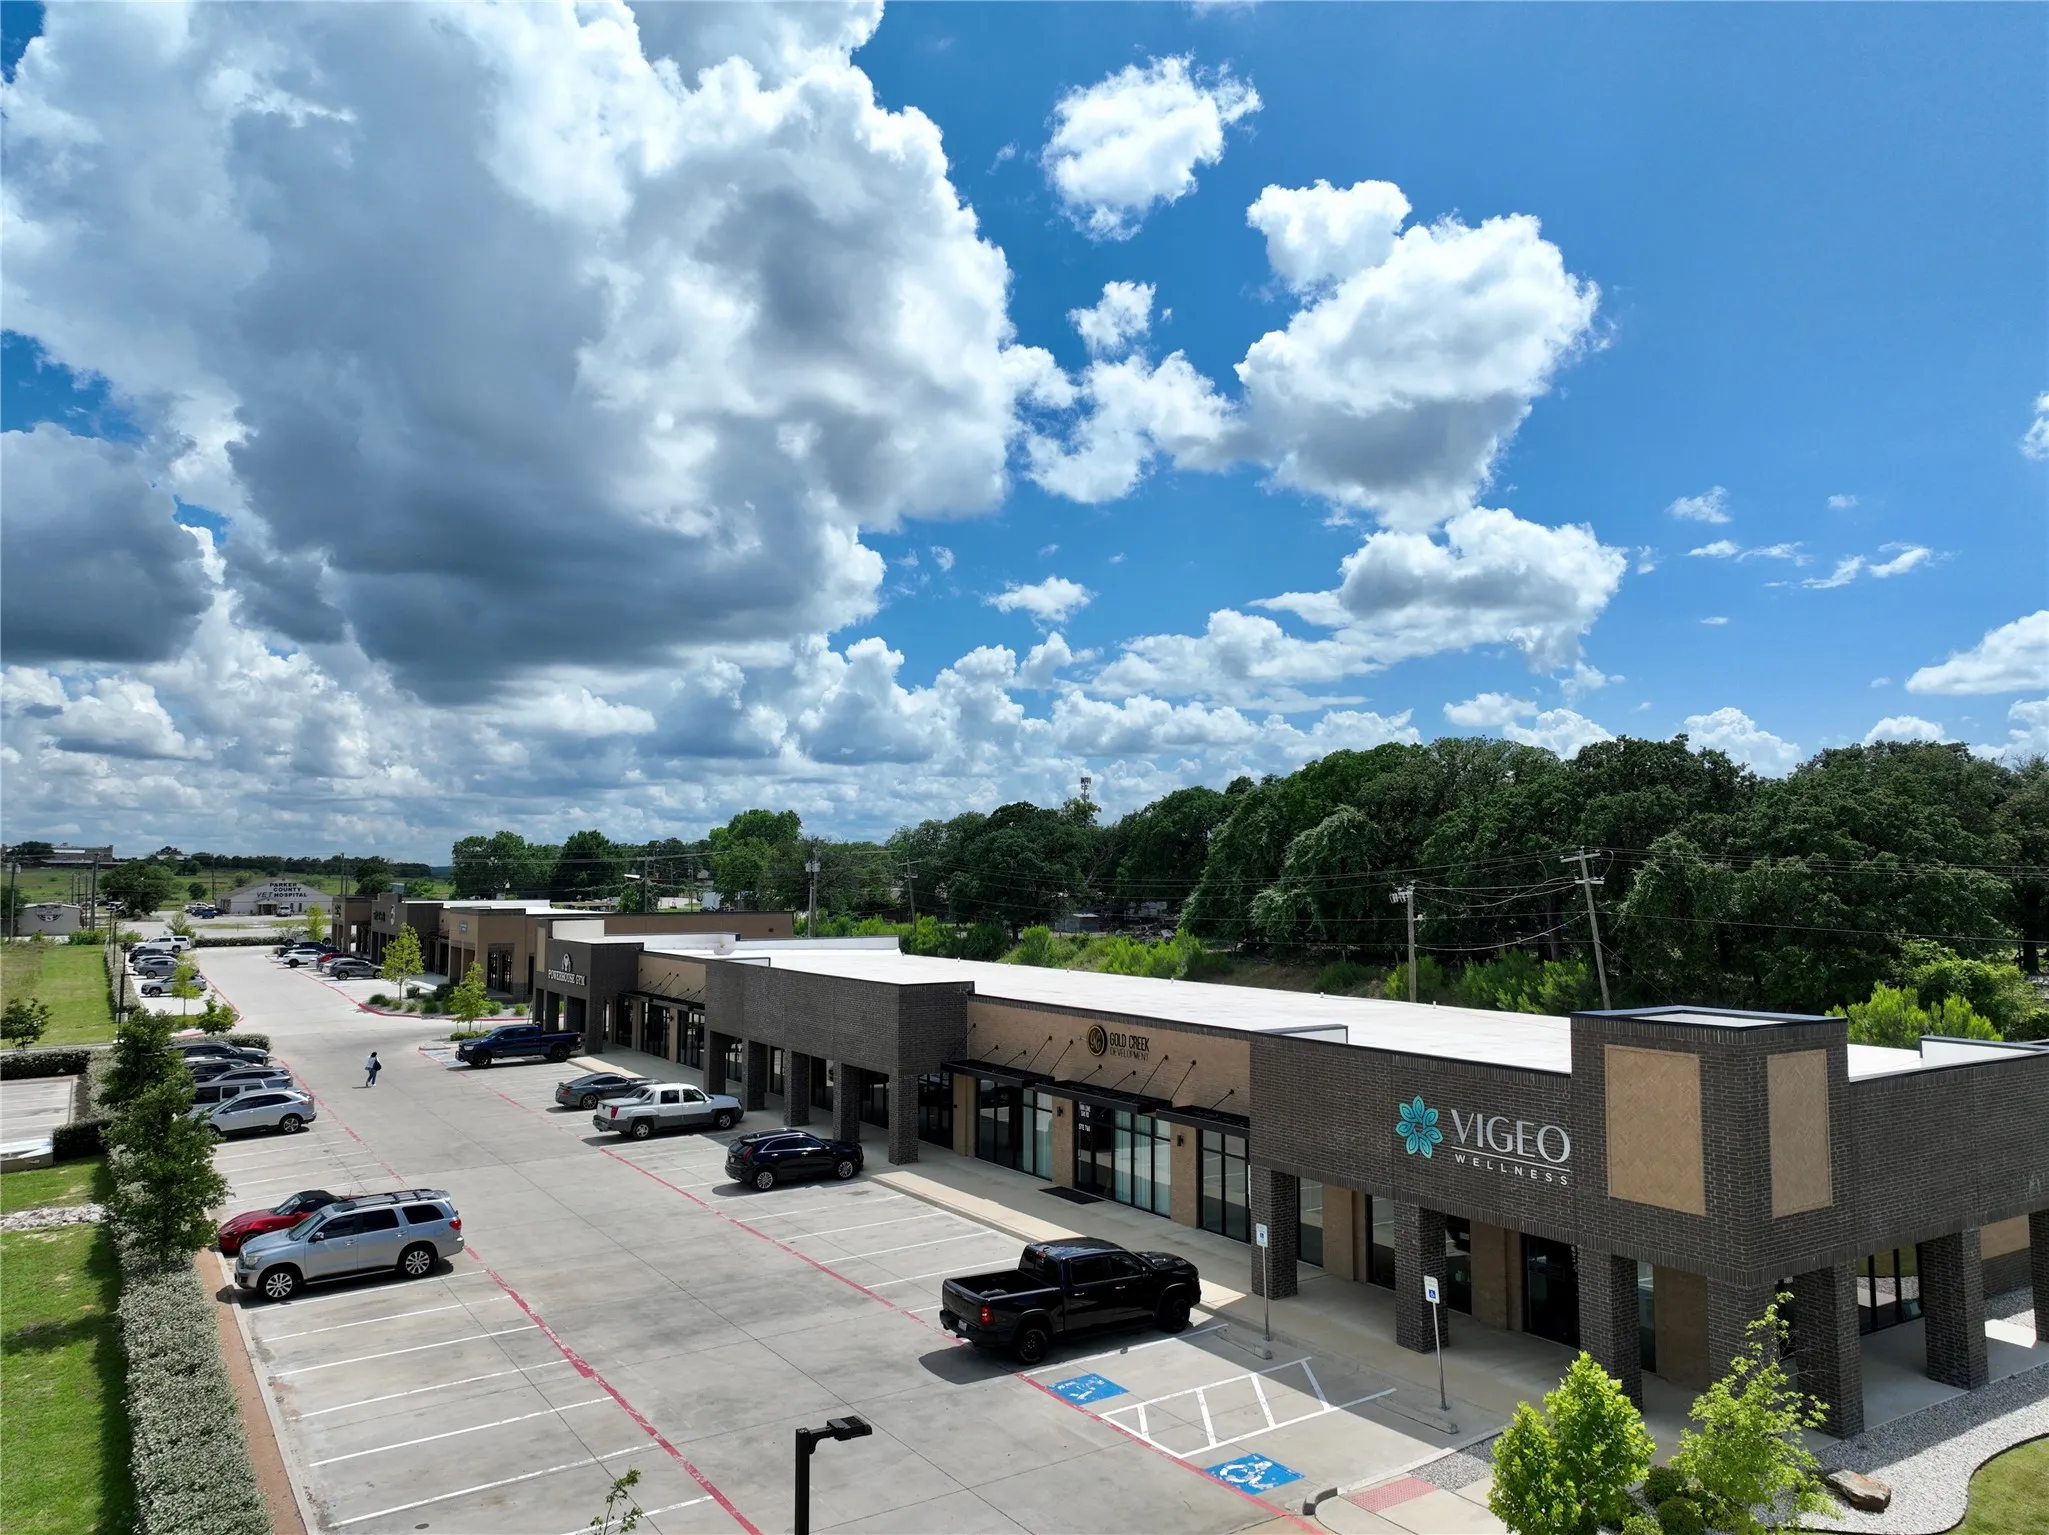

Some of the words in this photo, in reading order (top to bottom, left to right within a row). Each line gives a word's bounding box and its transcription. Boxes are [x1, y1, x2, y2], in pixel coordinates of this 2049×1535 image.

[548, 969, 575, 984] POWERHOUSE
[575, 974, 586, 986] GYM
[1110, 1032, 1127, 1048] GOLD
[1128, 1035, 1150, 1052] CREEK
[1110, 1047, 1149, 1061] DEVELOPMENT
[1450, 1108, 1571, 1164] VIGEO
[1454, 1153, 1568, 1186] WELLNESS
